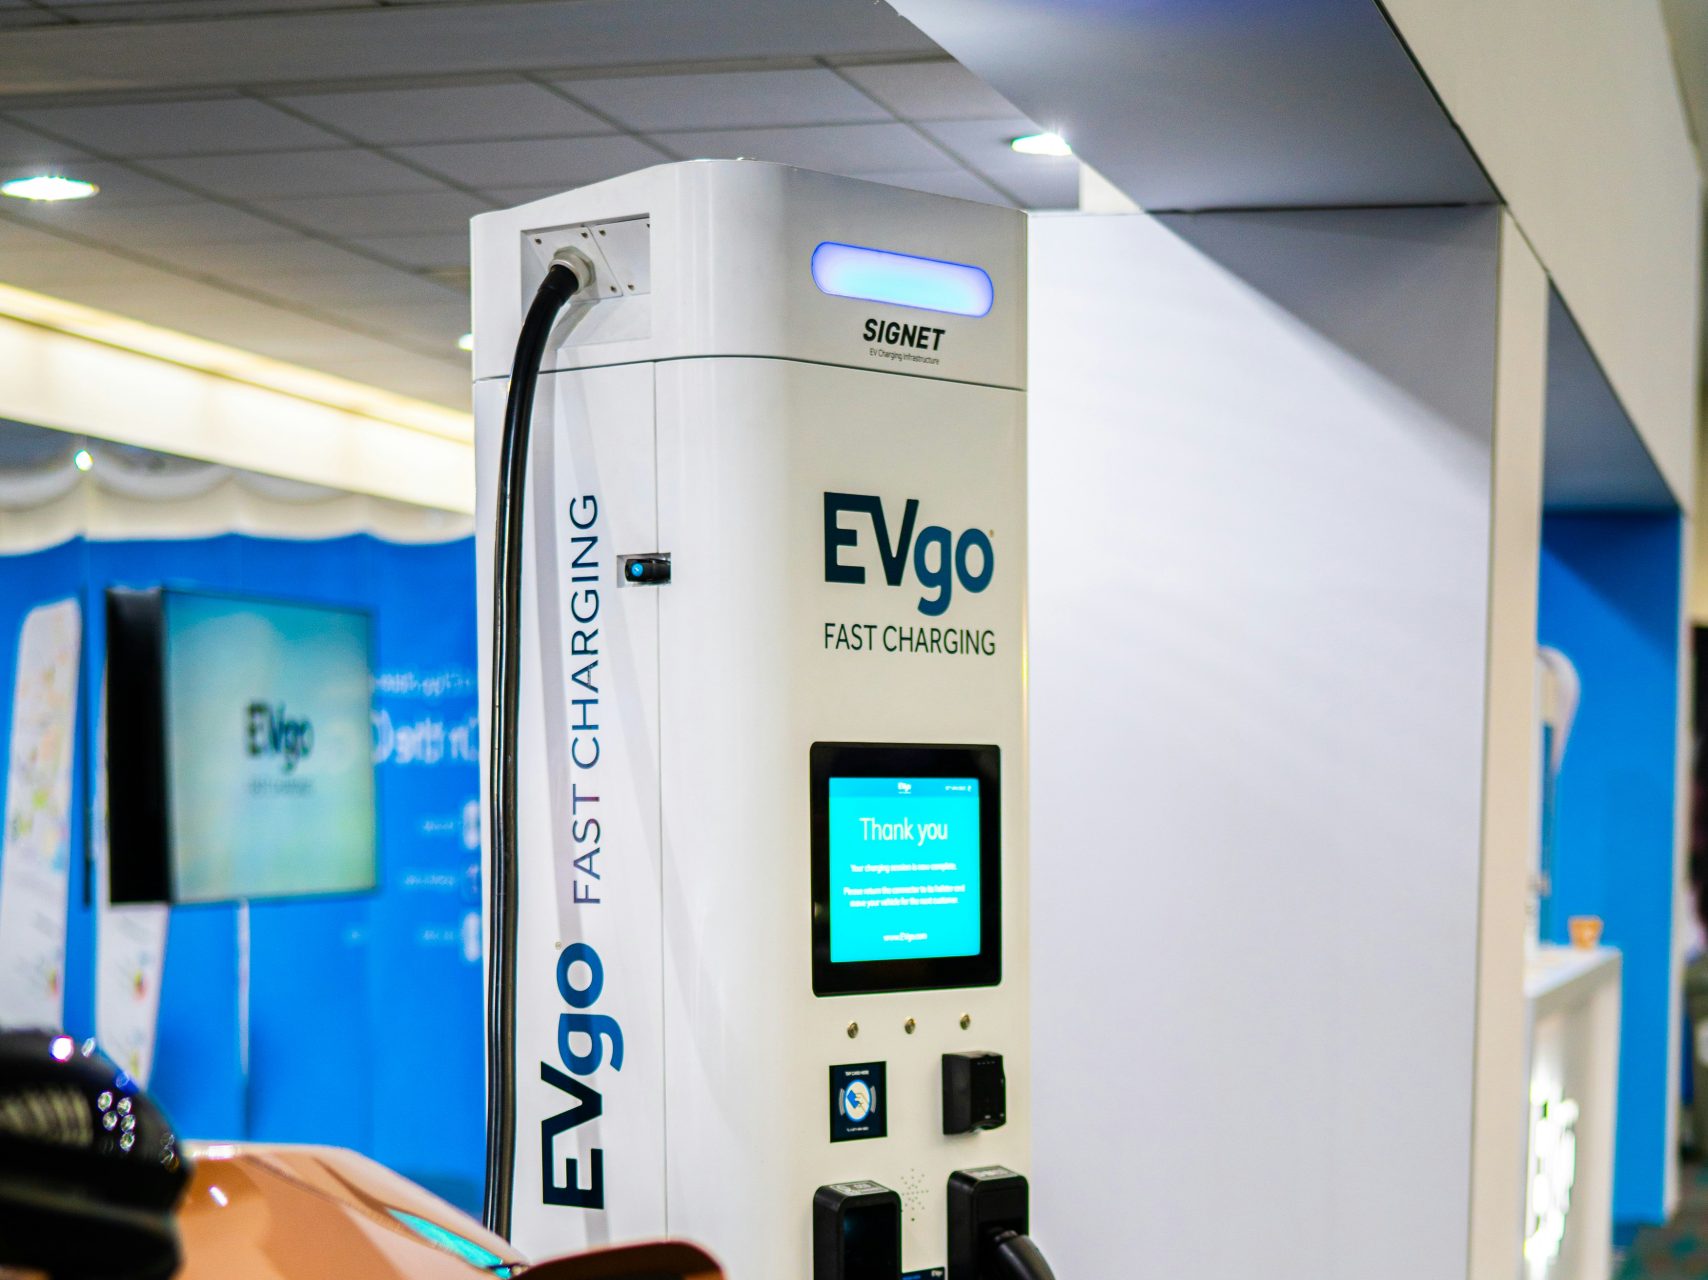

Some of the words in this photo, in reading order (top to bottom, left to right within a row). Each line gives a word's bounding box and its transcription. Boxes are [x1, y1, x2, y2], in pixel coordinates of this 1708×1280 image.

[863, 318, 946, 351] SIGNET
[823, 491, 995, 617] EVgo
[568, 494, 601, 771] CHARGING
[824, 622, 878, 651] FAST
[883, 625, 996, 656] CHARGING
[573, 784, 601, 905] FAST
[860, 817, 914, 841] Thank
[917, 822, 948, 847] you
[540, 942, 624, 1210] EVgo
